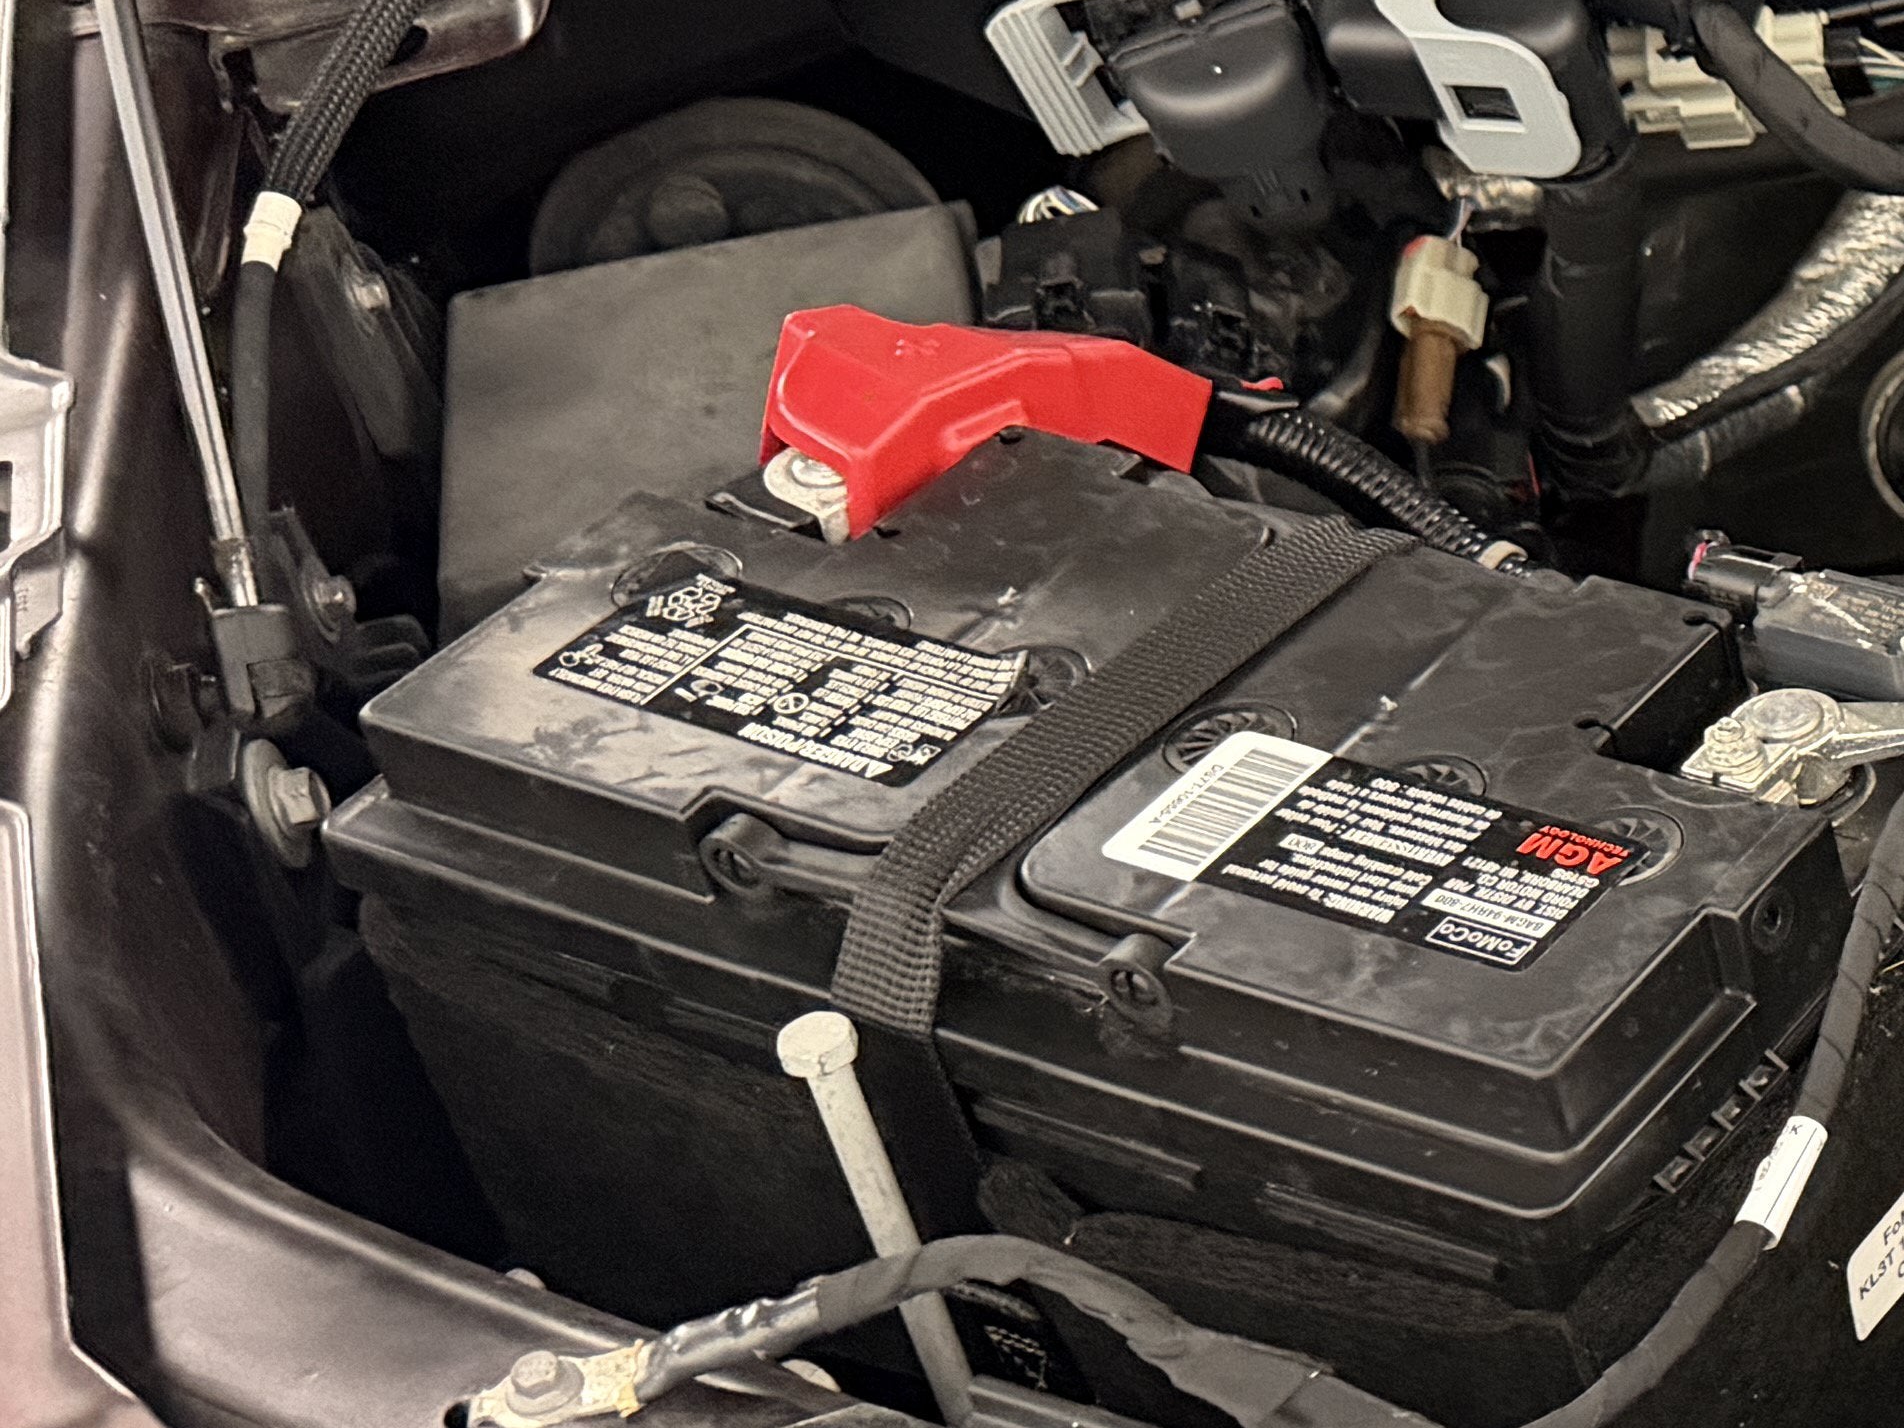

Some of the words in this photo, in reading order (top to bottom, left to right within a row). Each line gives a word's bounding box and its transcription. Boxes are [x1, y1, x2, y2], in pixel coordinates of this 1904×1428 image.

[735, 720, 871, 773] DANGER/POISON
[1339, 826, 1456, 867] AVERTISSEMENT
[1537, 824, 1632, 856] TECHNOLOGY
[1513, 832, 1624, 877] AGM
[1270, 877, 1311, 896] avoid
[1355, 872, 1391, 888] start
[1399, 869, 1434, 886] Cold
[1441, 877, 1476, 893] PAR
[1494, 879, 1545, 899] MOTOR
[1316, 891, 1398, 923] WARNING:
[1511, 897, 1537, 911] BY
[1539, 891, 1580, 909] FORD
[1432, 922, 1529, 958] FoMoCo
[1858, 1248, 1895, 1300] KL3T
